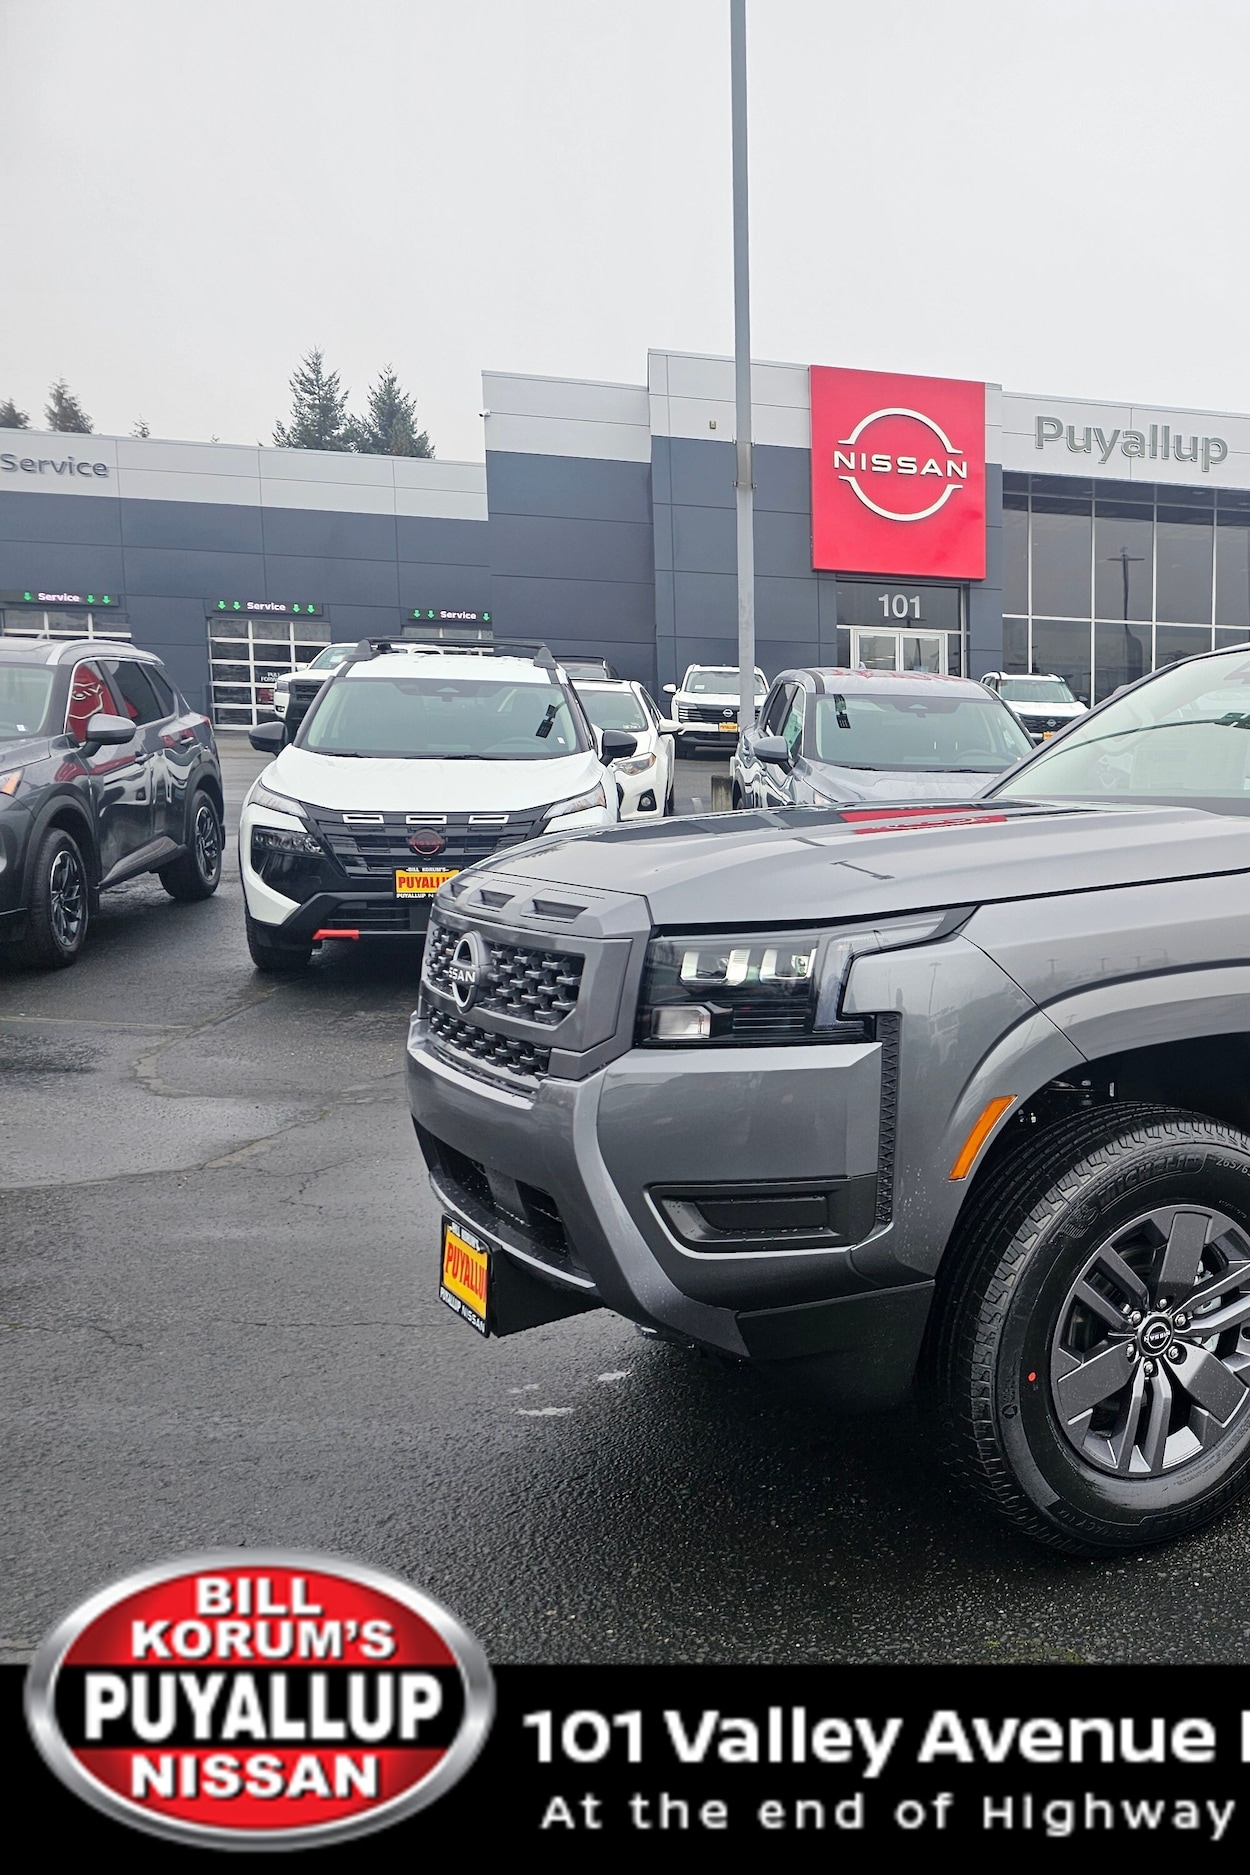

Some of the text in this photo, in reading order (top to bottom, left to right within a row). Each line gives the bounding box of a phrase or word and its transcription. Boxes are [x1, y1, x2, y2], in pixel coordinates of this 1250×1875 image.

[1035, 416, 1228, 472] Puyallup
[0, 453, 109, 478] Service
[833, 450, 968, 479] NISSAN
[38, 592, 80, 602] Service
[247, 602, 286, 611] Service
[878, 593, 921, 619] 101
[440, 611, 477, 620] Service
[398, 876, 450, 889] PUYALL
